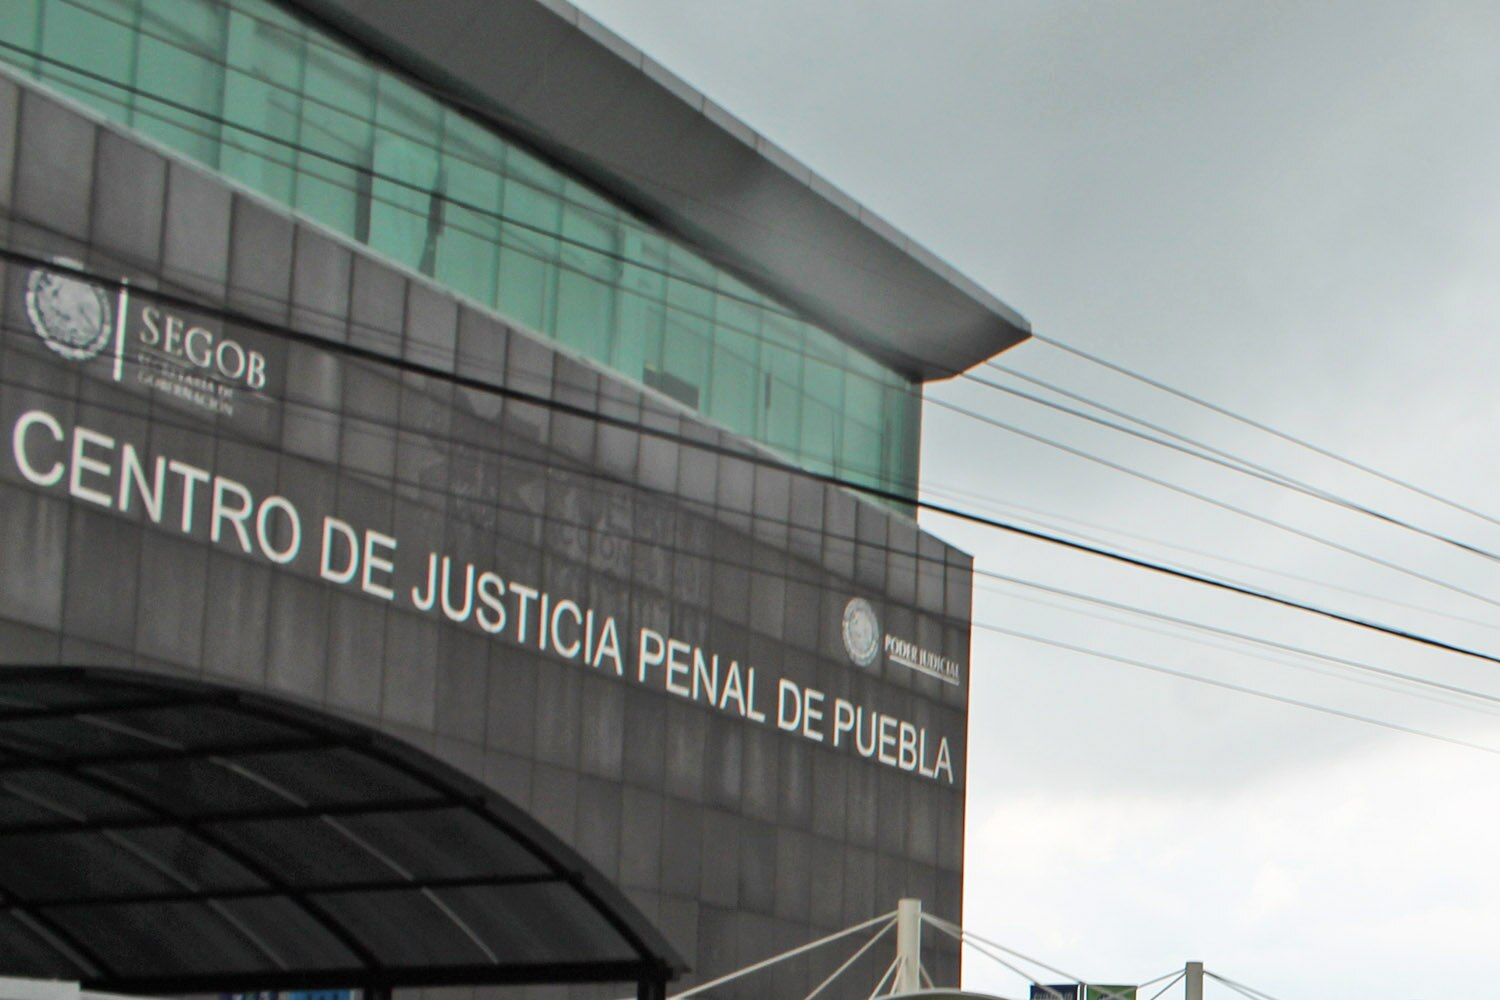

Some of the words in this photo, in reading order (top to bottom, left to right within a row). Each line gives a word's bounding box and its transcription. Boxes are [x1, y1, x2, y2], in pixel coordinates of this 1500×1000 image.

[138, 305, 267, 390] SEGOB
[13, 410, 301, 564] CENTRO
[320, 515, 398, 600] DE
[411, 552, 623, 676] JUSTICIA
[638, 627, 766, 723] PENAL
[777, 677, 825, 742] DE
[834, 697, 954, 785] PUEBLA
[884, 633, 918, 664] PODER
[919, 646, 960, 680] JUDICIAL
